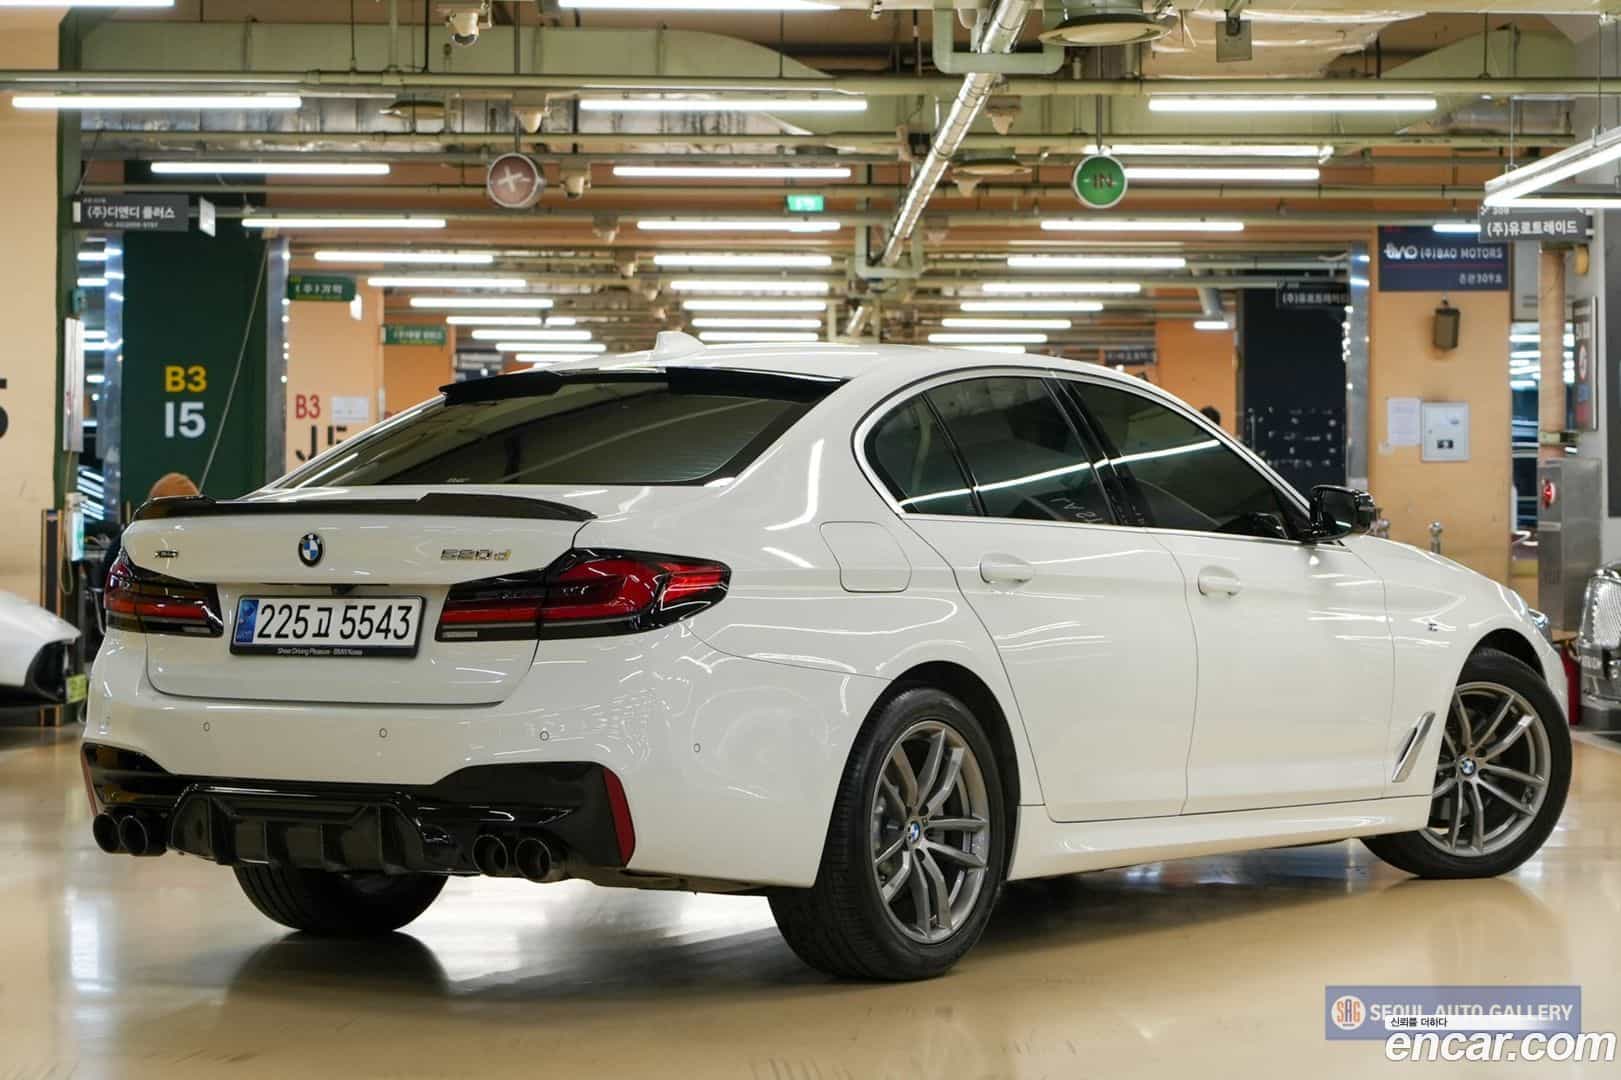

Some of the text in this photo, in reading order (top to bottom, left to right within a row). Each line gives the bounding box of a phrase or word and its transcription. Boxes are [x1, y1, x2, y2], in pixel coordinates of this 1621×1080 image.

[1093, 174, 1113, 189] IN
[1487, 219, 1579, 237] (주)유로트레이드
[1460, 247, 1503, 259] MOTORS
[165, 365, 208, 393] B3
[295, 394, 321, 419] B3
[339, 604, 413, 640] 5543
